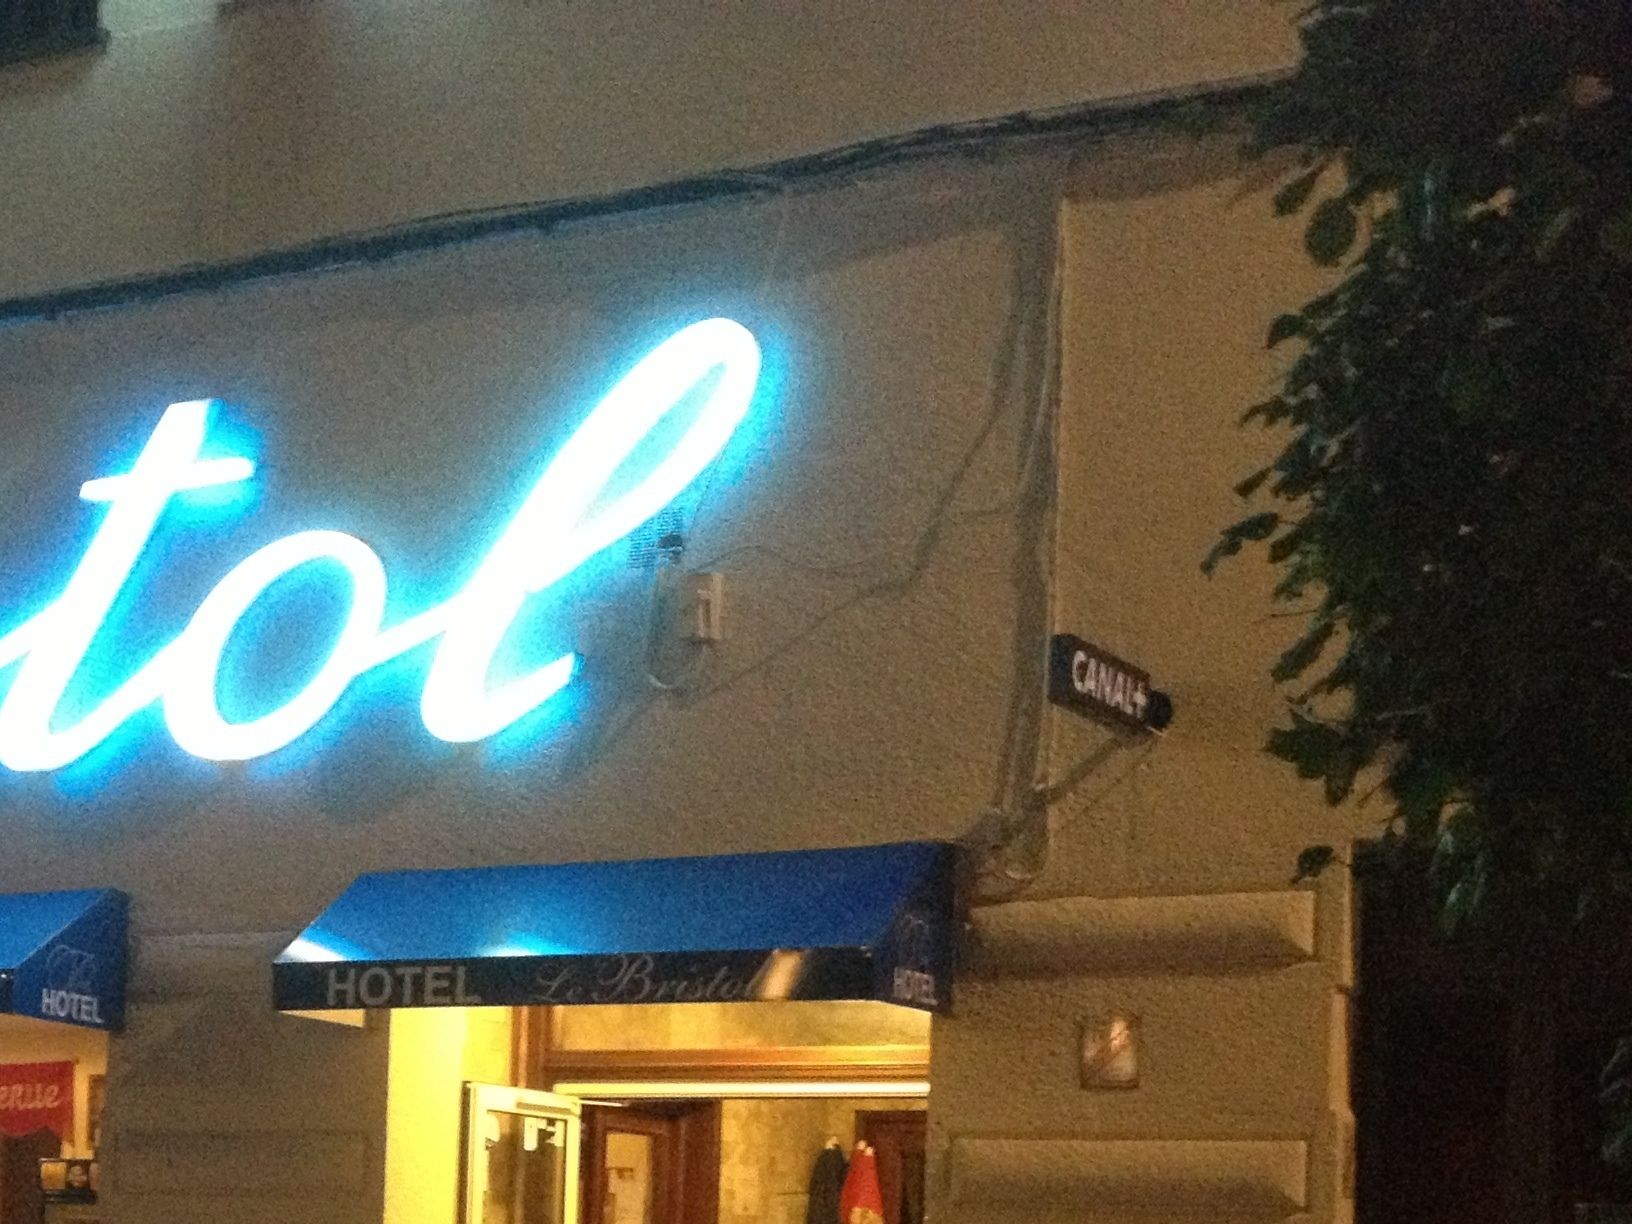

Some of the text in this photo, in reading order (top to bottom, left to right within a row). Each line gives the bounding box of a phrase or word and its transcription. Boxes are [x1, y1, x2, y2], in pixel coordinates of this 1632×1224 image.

[326, 951, 782, 1006] HOTEL Le Bristol
[41, 987, 104, 1024] HOTEL
